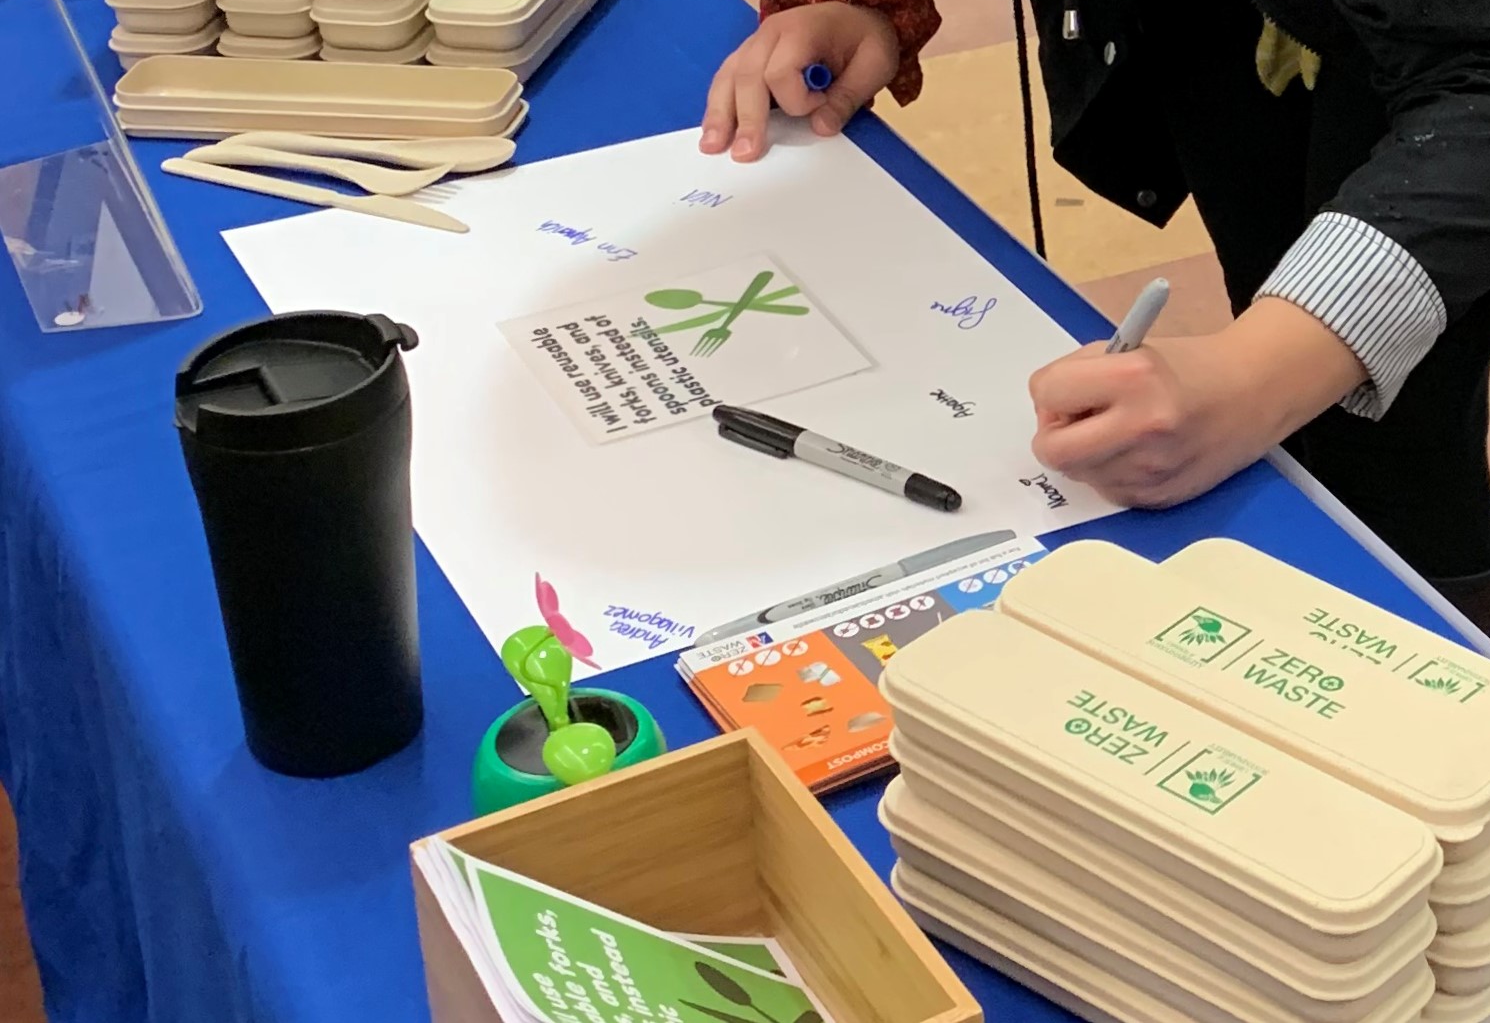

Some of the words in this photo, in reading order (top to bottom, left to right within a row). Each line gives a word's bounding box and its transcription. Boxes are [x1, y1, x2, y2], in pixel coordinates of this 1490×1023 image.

[556, 322, 591, 345] and
[584, 314, 613, 328] of
[629, 316, 680, 366] utensils.
[530, 327, 585, 379] reusable
[584, 344, 628, 390] knives,
[596, 327, 651, 375] instead
[574, 379, 602, 402] use
[620, 386, 657, 425] forks,
[640, 372, 690, 416] spoons
[668, 366, 724, 409] plastic
[586, 401, 622, 427] will
[606, 425, 629, 434] I
[609, 620, 669, 650] Andrea
[1303, 607, 1398, 659] WASTE
[1242, 663, 1347, 720] WASTE
[1260, 647, 1345, 692] ZERO
[1064, 717, 1150, 765] ZERO
[1066, 689, 1169, 748] WASTE
[535, 908, 577, 978] forks,
[532, 972, 569, 1010] use
[575, 960, 620, 1008] and
[590, 927, 654, 1017] instead
